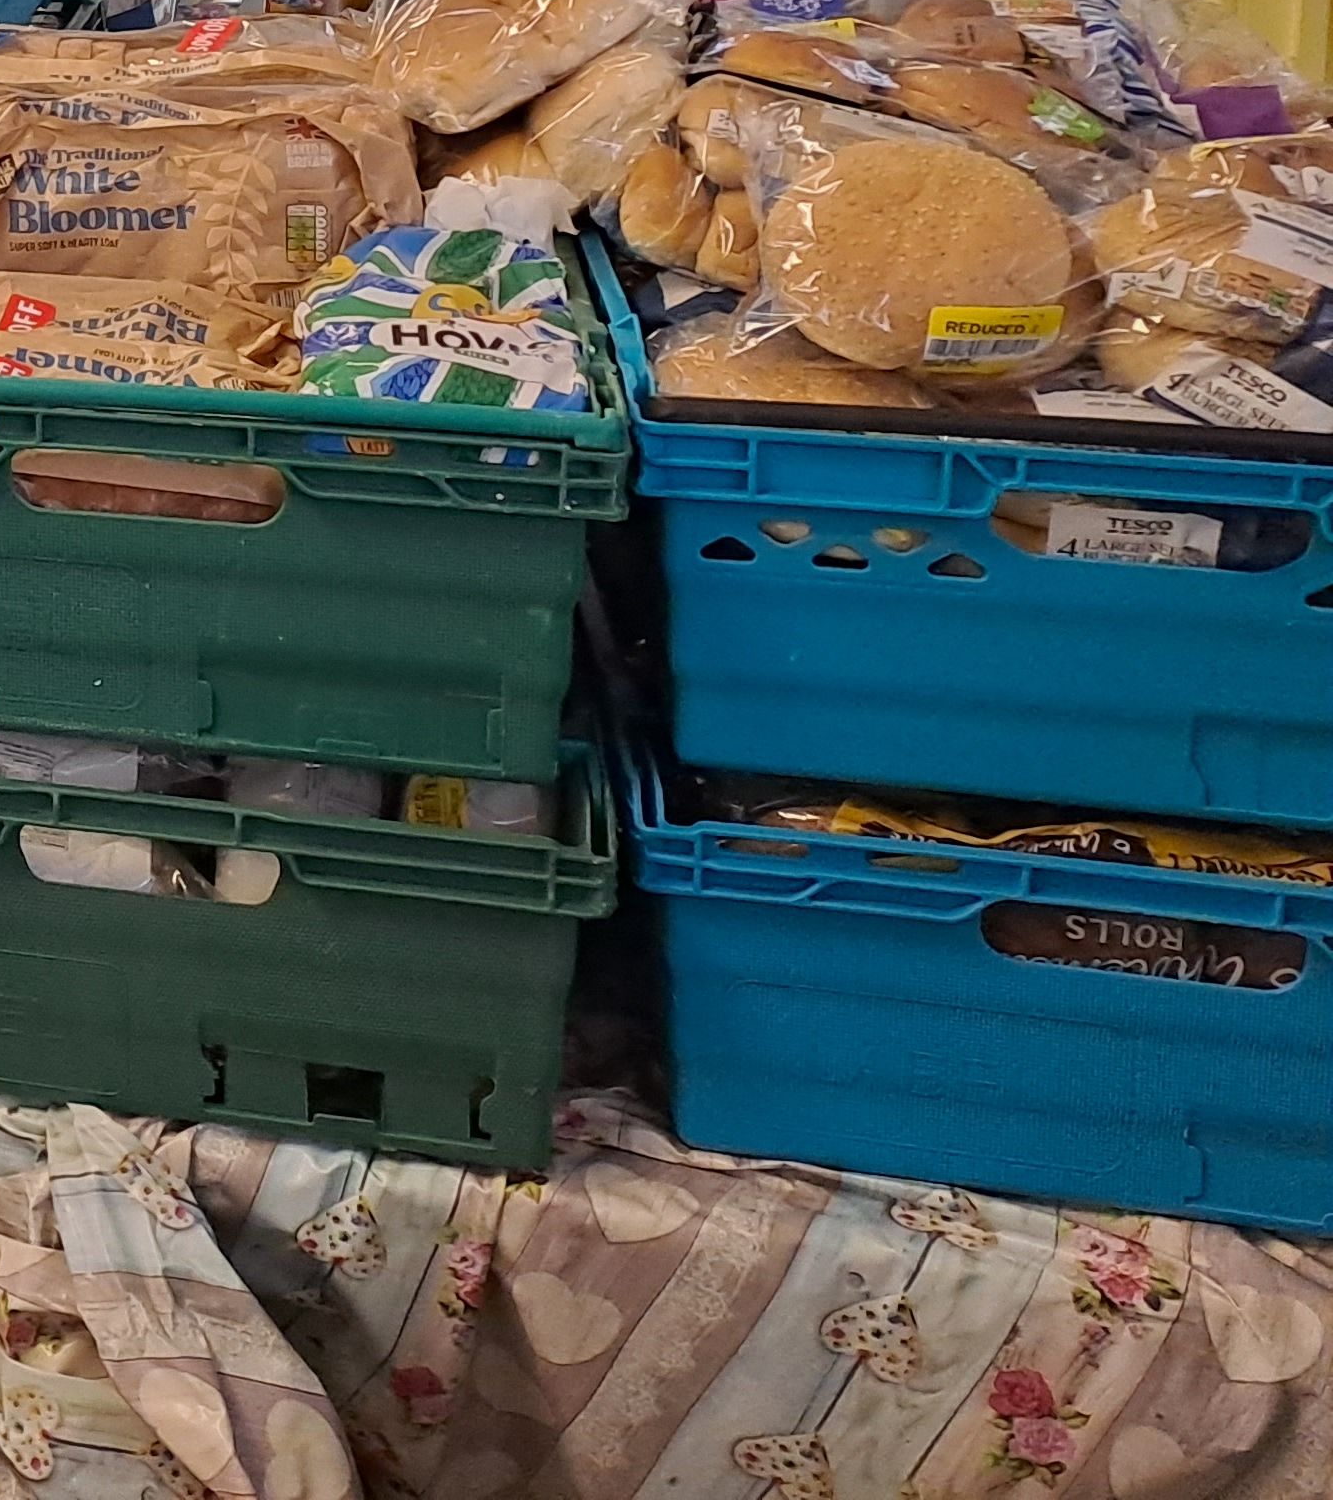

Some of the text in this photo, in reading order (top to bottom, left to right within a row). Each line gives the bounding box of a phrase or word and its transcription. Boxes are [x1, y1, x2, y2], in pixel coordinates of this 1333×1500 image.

[20, 101, 111, 122] White
[115, 91, 202, 121] Traditional
[19, 146, 165, 166] The Traditional
[287, 154, 333, 169] BRITAIN
[14, 163, 141, 195] White
[8, 200, 196, 234] Bloomer
[9, 240, 35, 252] SUPER
[38, 240, 58, 250] SOFT
[68, 238, 98, 249] HEARTY
[945, 321, 1025, 334] REDUCED
[1165, 373, 1247, 410] 4 LARGE
[1226, 362, 1288, 403] TESCO
[1107, 516, 1174, 531] TESCO
[1057, 537, 1145, 558] 4 LARGE
[1064, 913, 1184, 953] ROLLS
